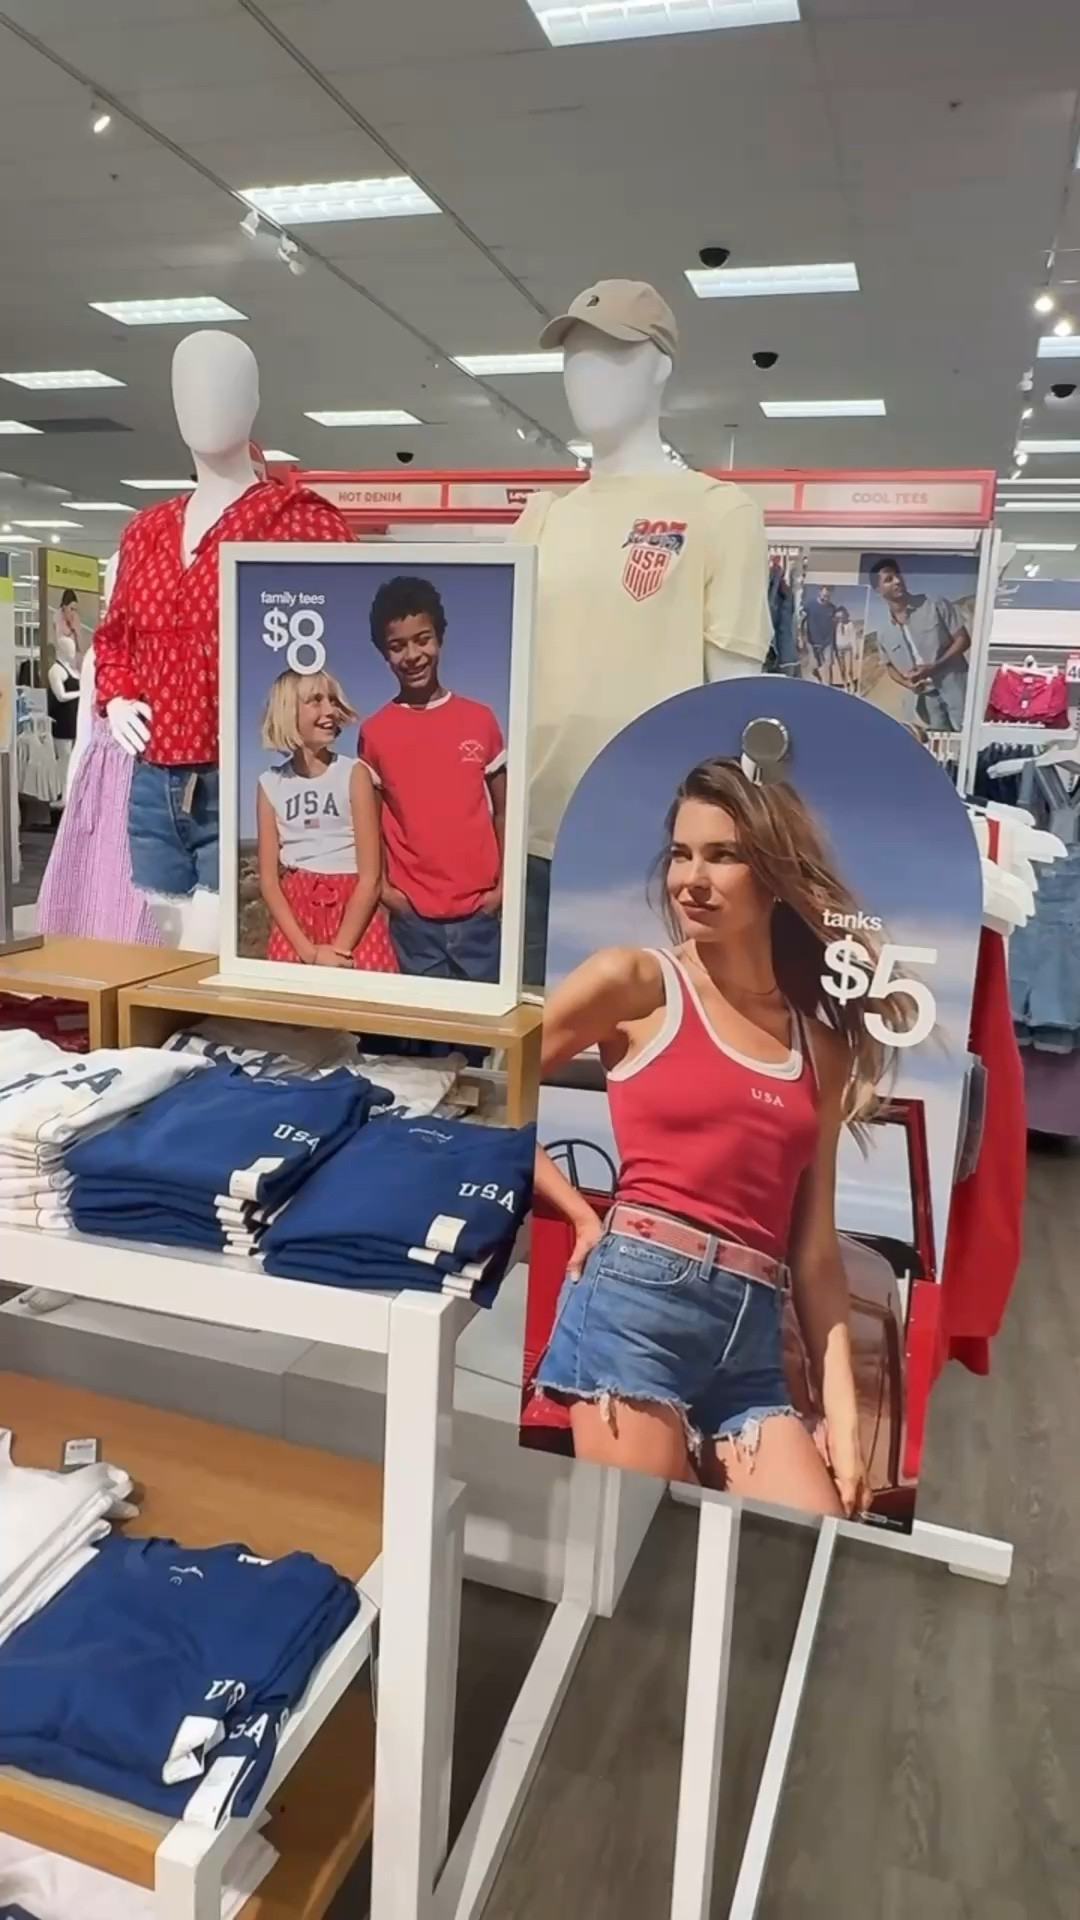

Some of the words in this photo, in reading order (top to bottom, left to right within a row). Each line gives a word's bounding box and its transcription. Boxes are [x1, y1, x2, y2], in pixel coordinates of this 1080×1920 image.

[338, 491, 362, 502] HOT
[364, 491, 402, 502] DENIM
[852, 492, 890, 504] COOL
[895, 492, 928, 504] TEES
[632, 549, 667, 570] USA
[261, 591, 297, 607] family
[299, 592, 325, 605] tees
[262, 606, 326, 675] $8
[286, 790, 340, 821] USA
[822, 908, 882, 931] tanks
[820, 933, 938, 1048] $5
[750, 1087, 785, 1108] USA
[273, 1123, 320, 1155] USA
[458, 1182, 516, 1214] USA
[204, 1679, 246, 1712] US
